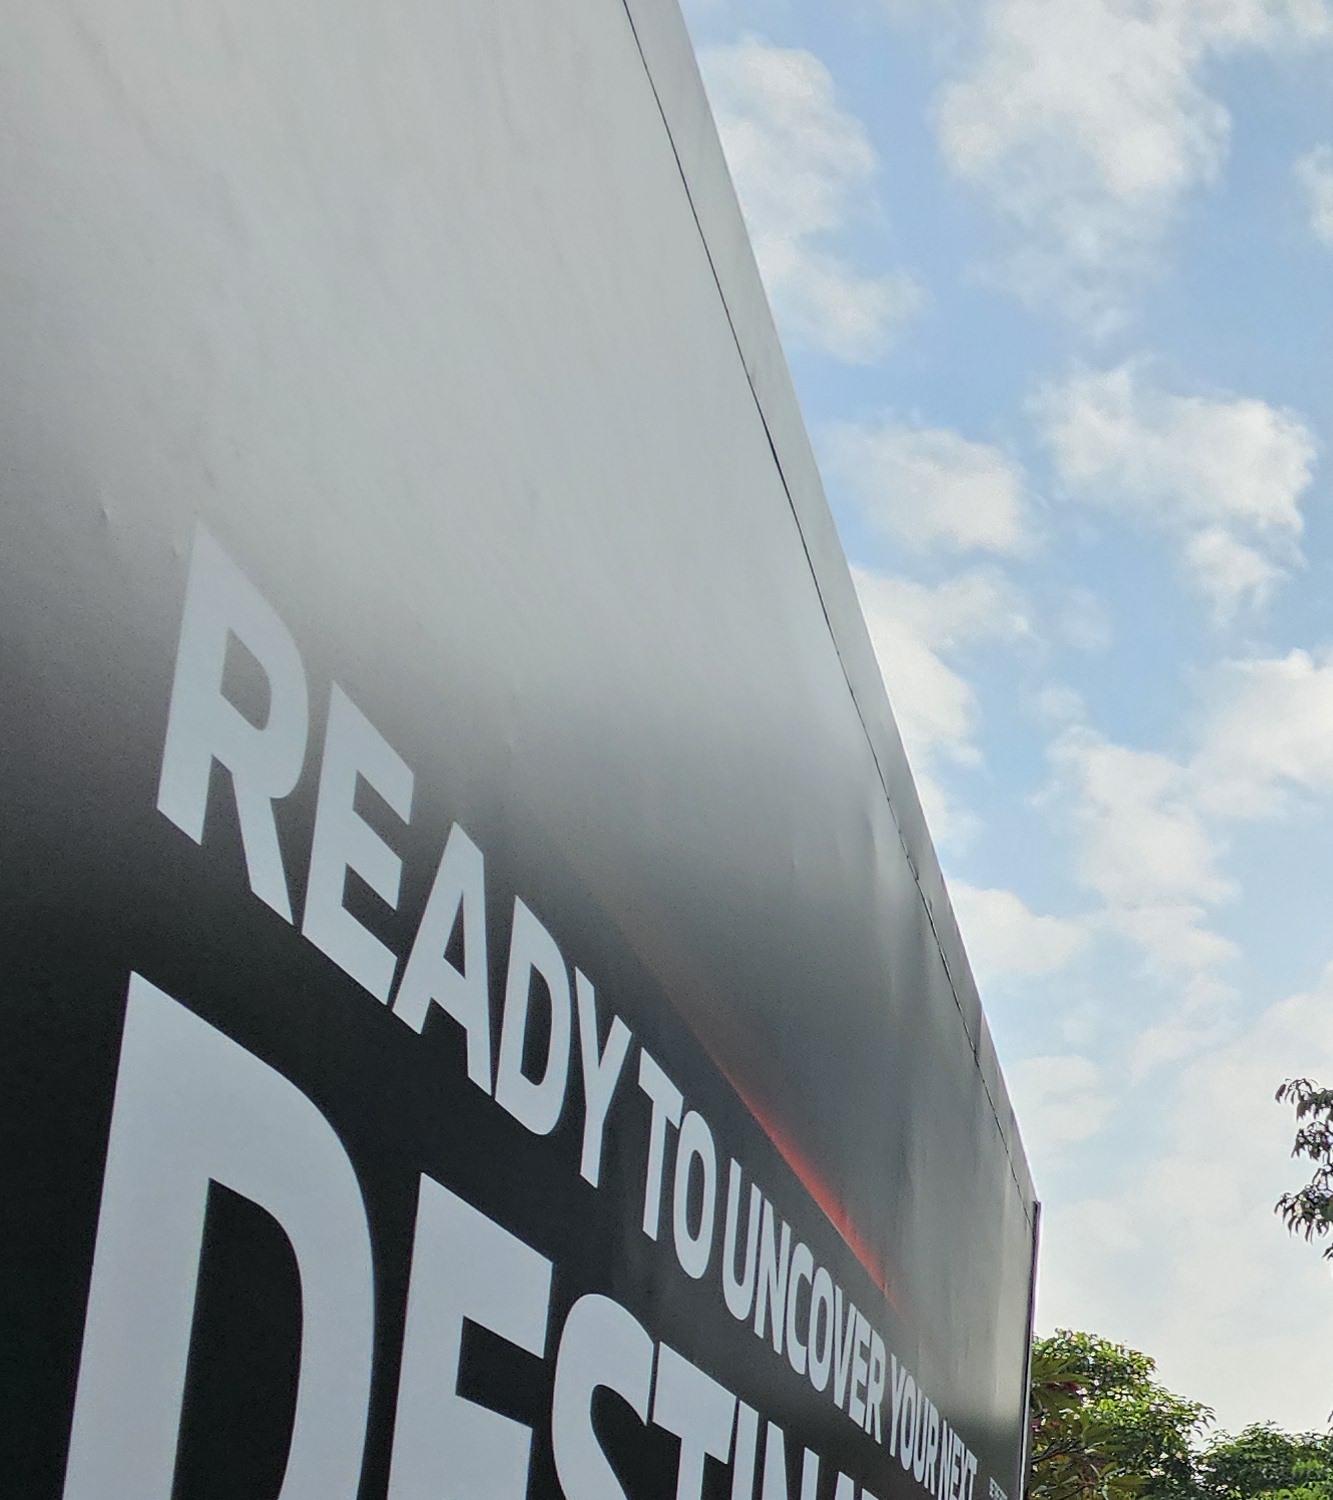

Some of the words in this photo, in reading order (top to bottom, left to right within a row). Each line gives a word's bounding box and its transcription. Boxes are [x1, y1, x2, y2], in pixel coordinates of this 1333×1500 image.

[156, 517, 632, 1188] READY
[638, 1046, 717, 1279] TO
[723, 1157, 886, 1444] UNCOVER
[890, 1353, 940, 1496] YOUR
